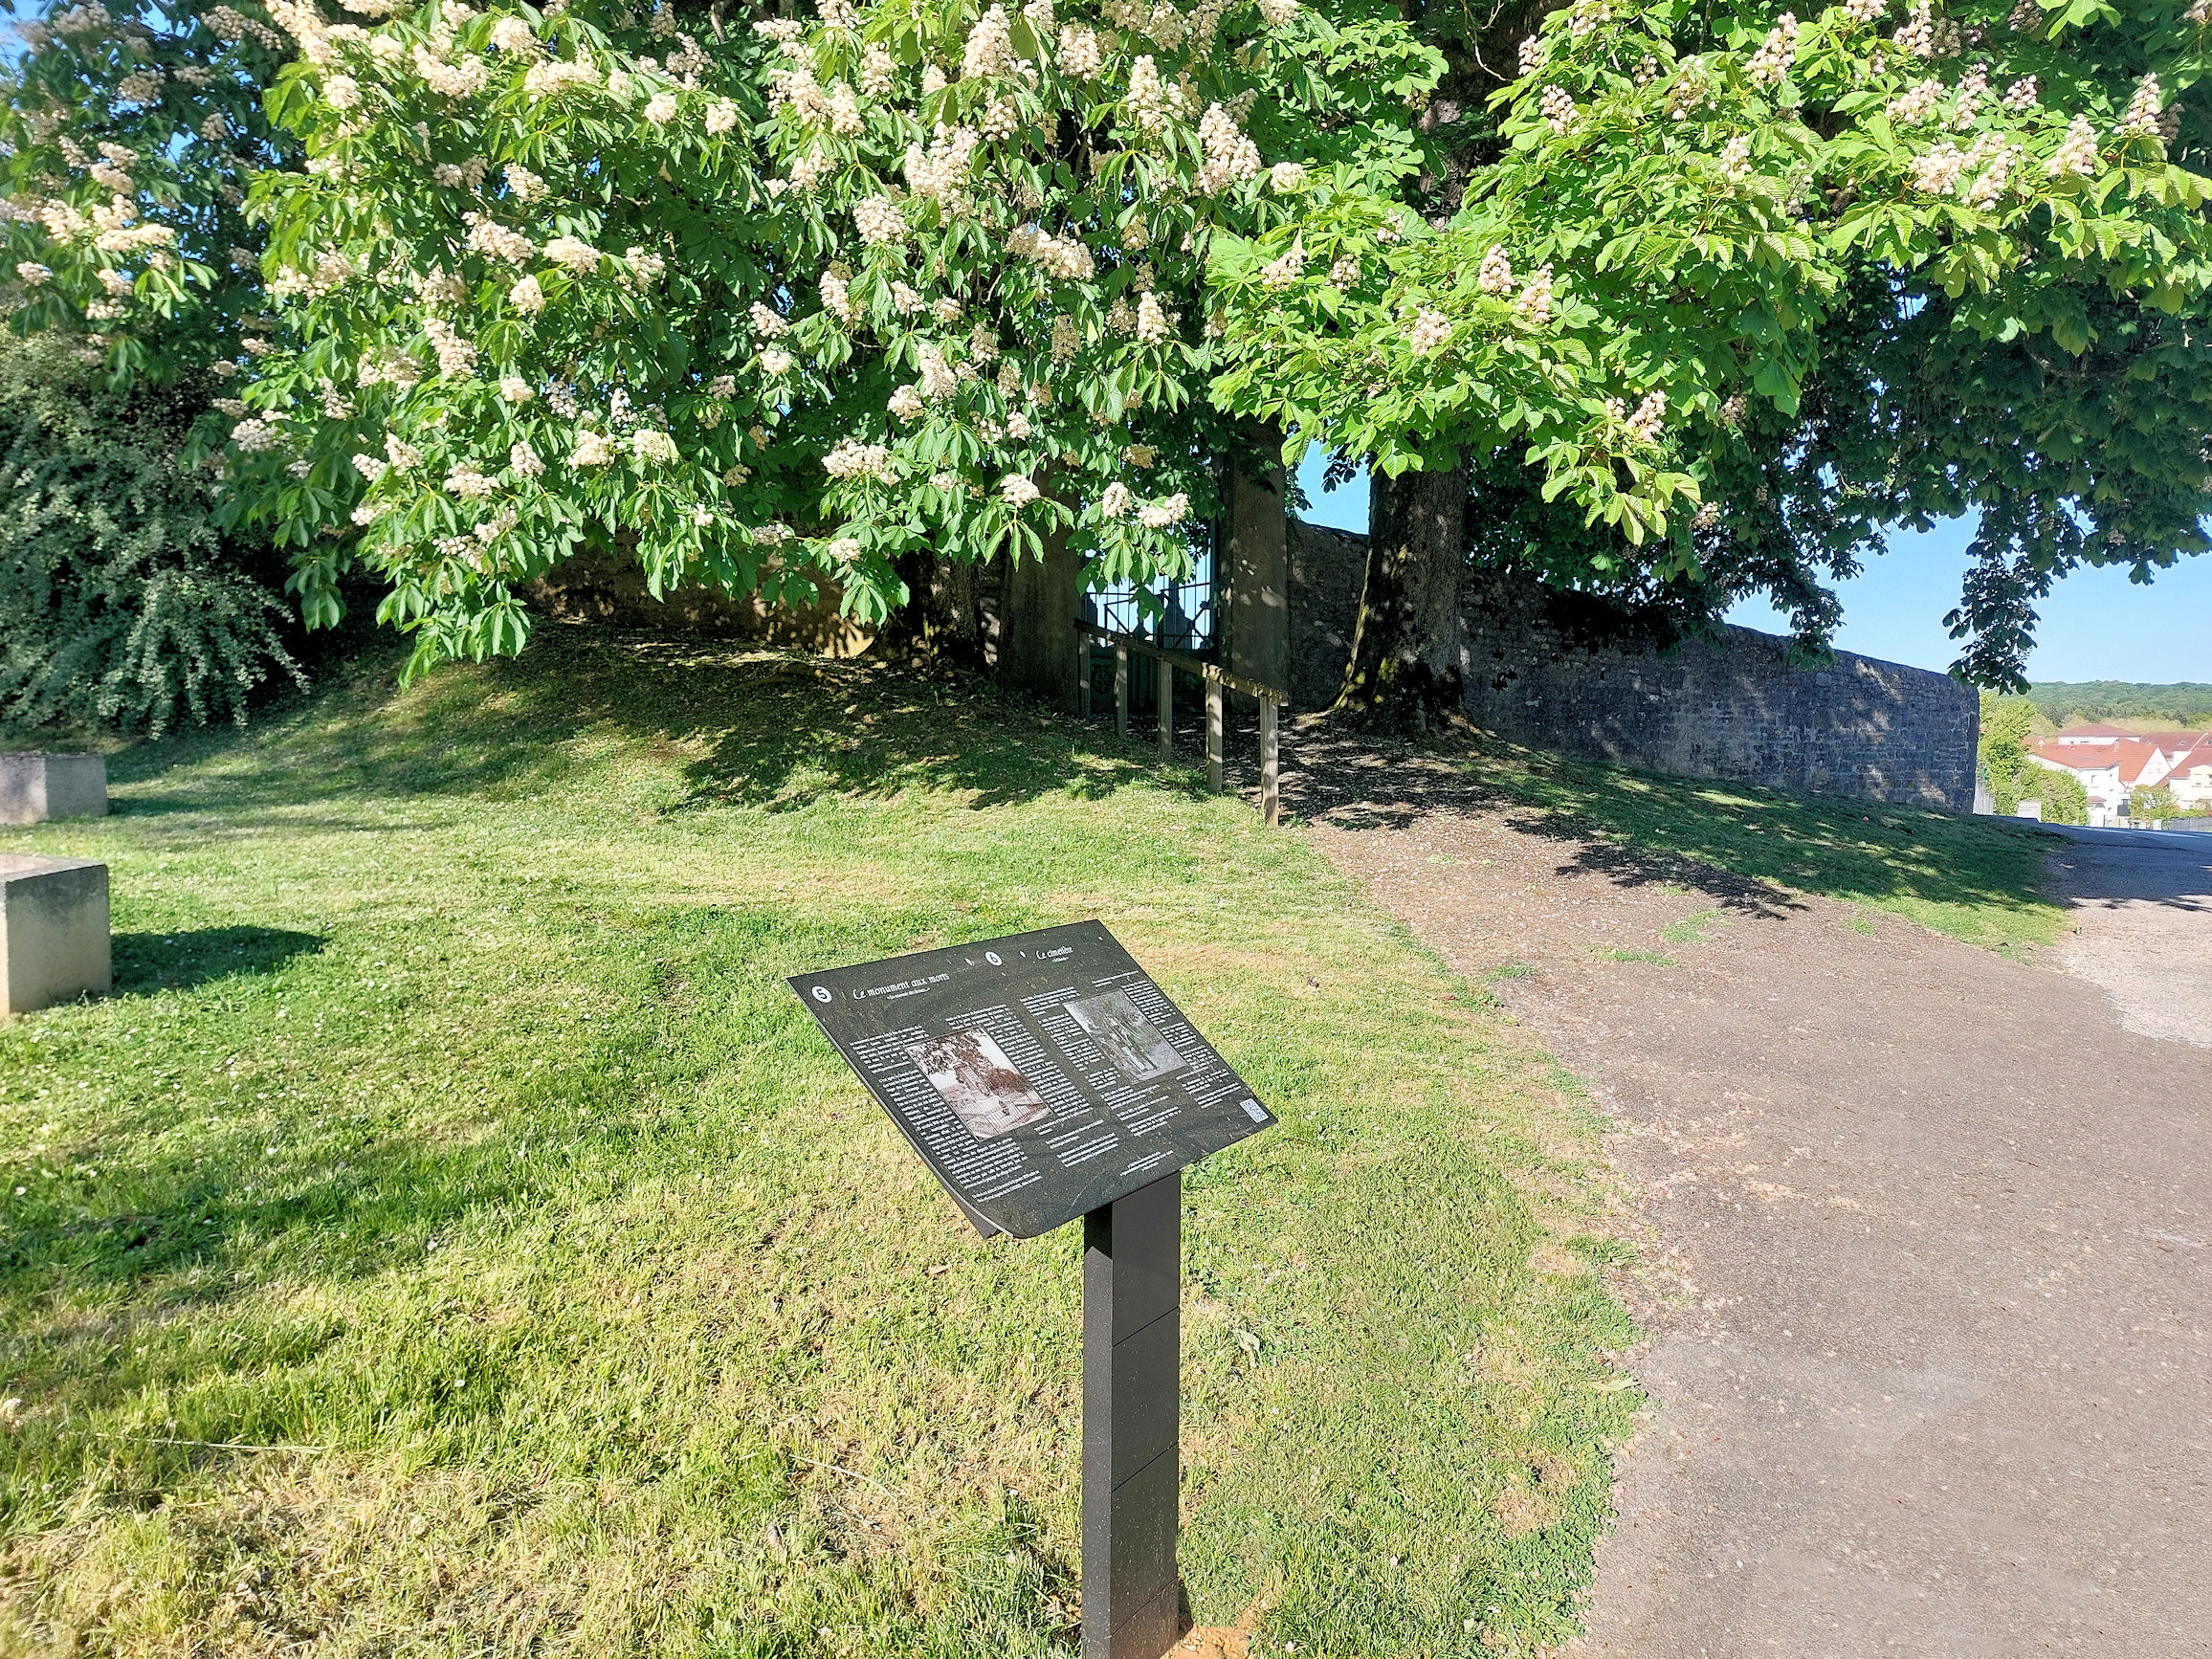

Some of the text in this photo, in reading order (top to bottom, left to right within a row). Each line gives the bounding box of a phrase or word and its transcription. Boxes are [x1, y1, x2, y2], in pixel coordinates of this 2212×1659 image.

[989, 953, 998, 962] 6
[1035, 950, 1047, 960] Le
[852, 988, 866, 1000] Le
[867, 982, 910, 997] monument
[911, 978, 927, 987] aux
[929, 973, 950, 984] morts
[816, 988, 828, 1000] 5
